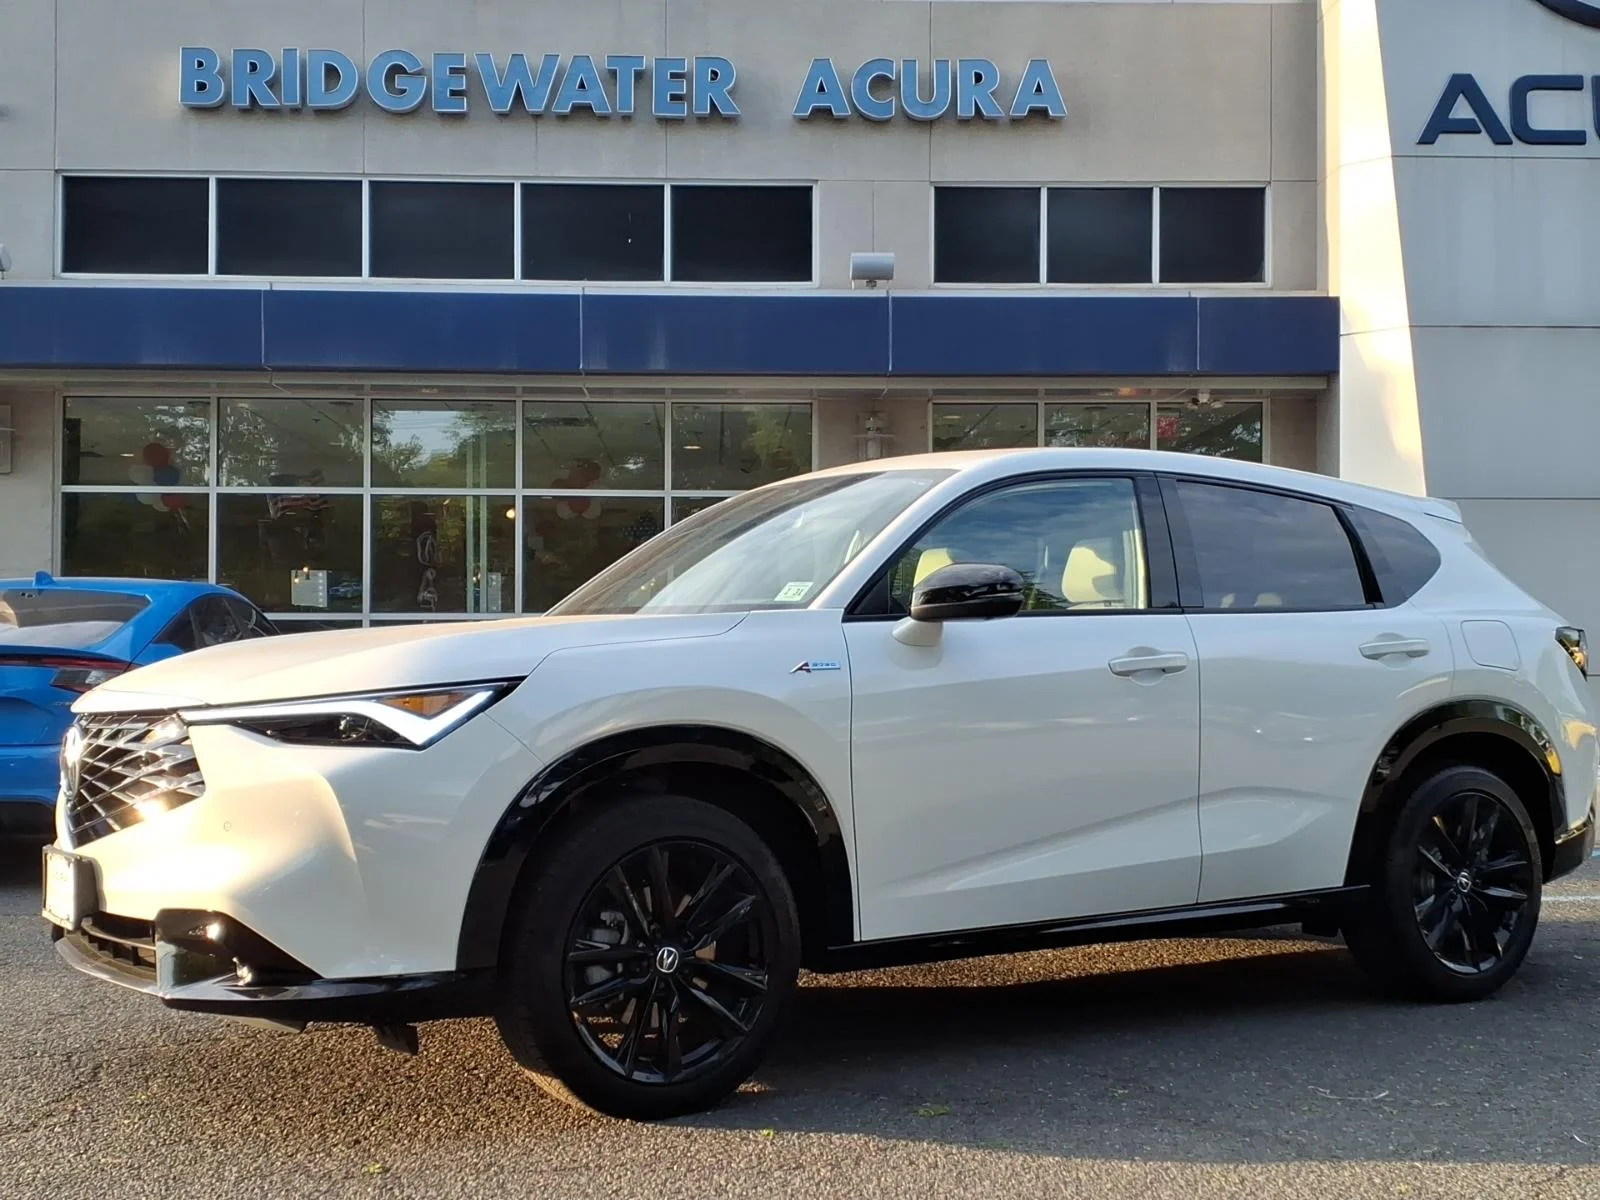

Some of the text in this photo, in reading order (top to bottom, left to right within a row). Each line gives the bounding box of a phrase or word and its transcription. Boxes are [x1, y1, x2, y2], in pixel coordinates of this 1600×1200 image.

[179, 46, 1068, 121] BRIDGEWATER ACURA
[1416, 73, 1600, 146] AC
